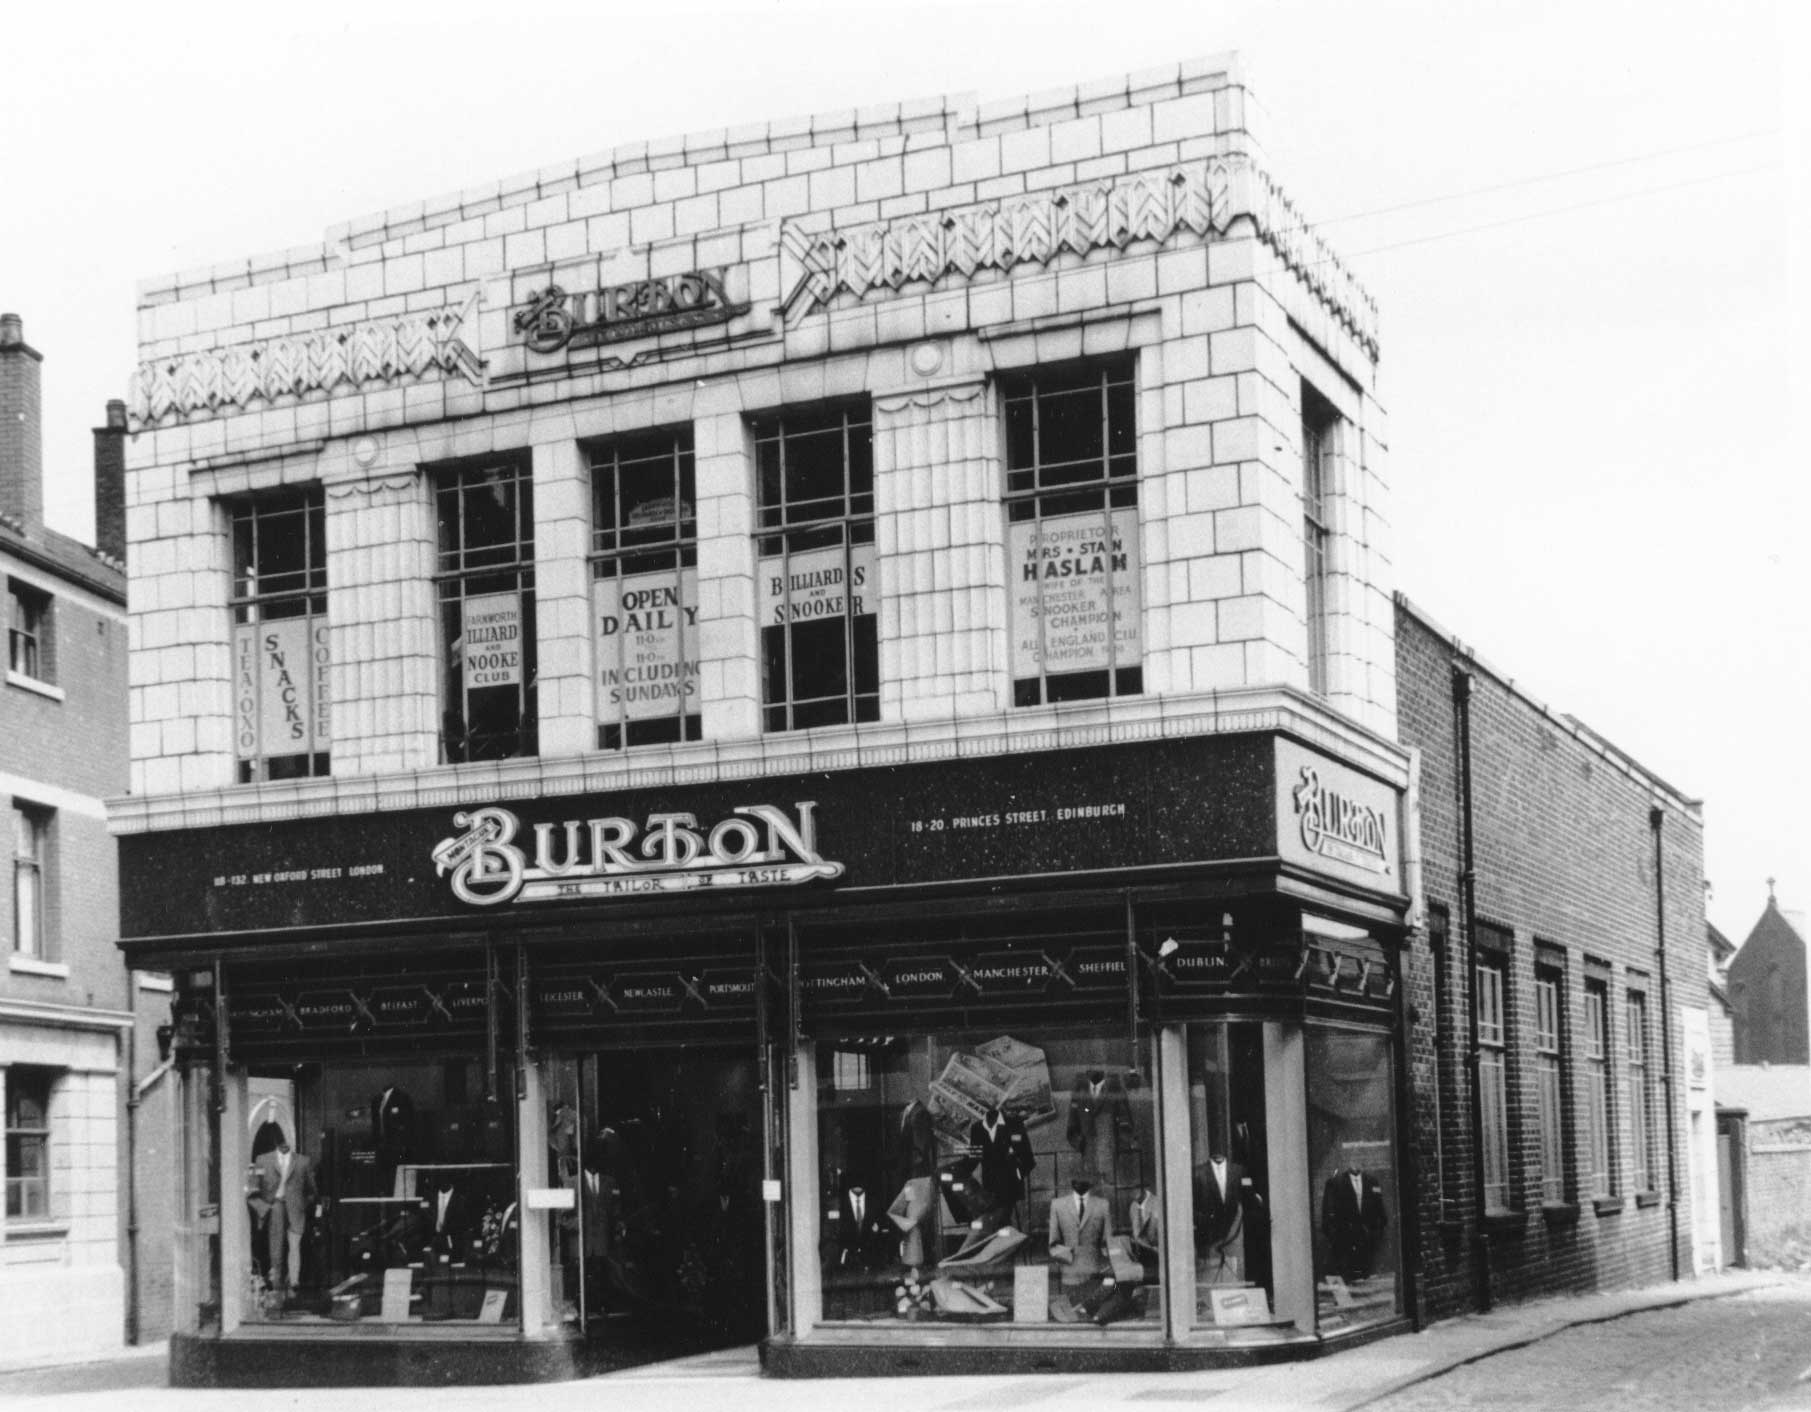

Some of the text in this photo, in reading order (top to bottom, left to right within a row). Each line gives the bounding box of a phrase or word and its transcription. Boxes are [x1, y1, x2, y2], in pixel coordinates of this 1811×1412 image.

[514, 266, 742, 352] BURTON
[1027, 539, 1122, 561] MRS STAN
[1023, 553, 1127, 582] HASLAM
[771, 566, 865, 596] BILLIARDS
[809, 589, 826, 597] AND
[621, 587, 679, 611] OPEN
[774, 595, 864, 624] SNOOKER
[1030, 601, 1096, 618] SNOOKER
[602, 605, 699, 636] DAILY
[1050, 611, 1122, 629] CHAMPION
[265, 634, 304, 740] SNACKS
[474, 671, 510, 683] CLUB
[610, 680, 695, 704] SUNDAYS
[952, 813, 1000, 830] PRINCES
[1005, 809, 1047, 825] STREET
[1057, 803, 1126, 820] EDINBURGH
[434, 801, 834, 904] BURTON
[252, 873, 272, 884] NEW
[310, 867, 342, 879] STREET
[348, 864, 384, 876] LONDON
[557, 883, 583, 895] THE
[603, 878, 665, 893] TAILOR
[737, 869, 792, 885] TASTE
[896, 971, 944, 984] LONDON
[973, 966, 1049, 980] MANCHESTER
[623, 987, 673, 998] NEWCASTLE
